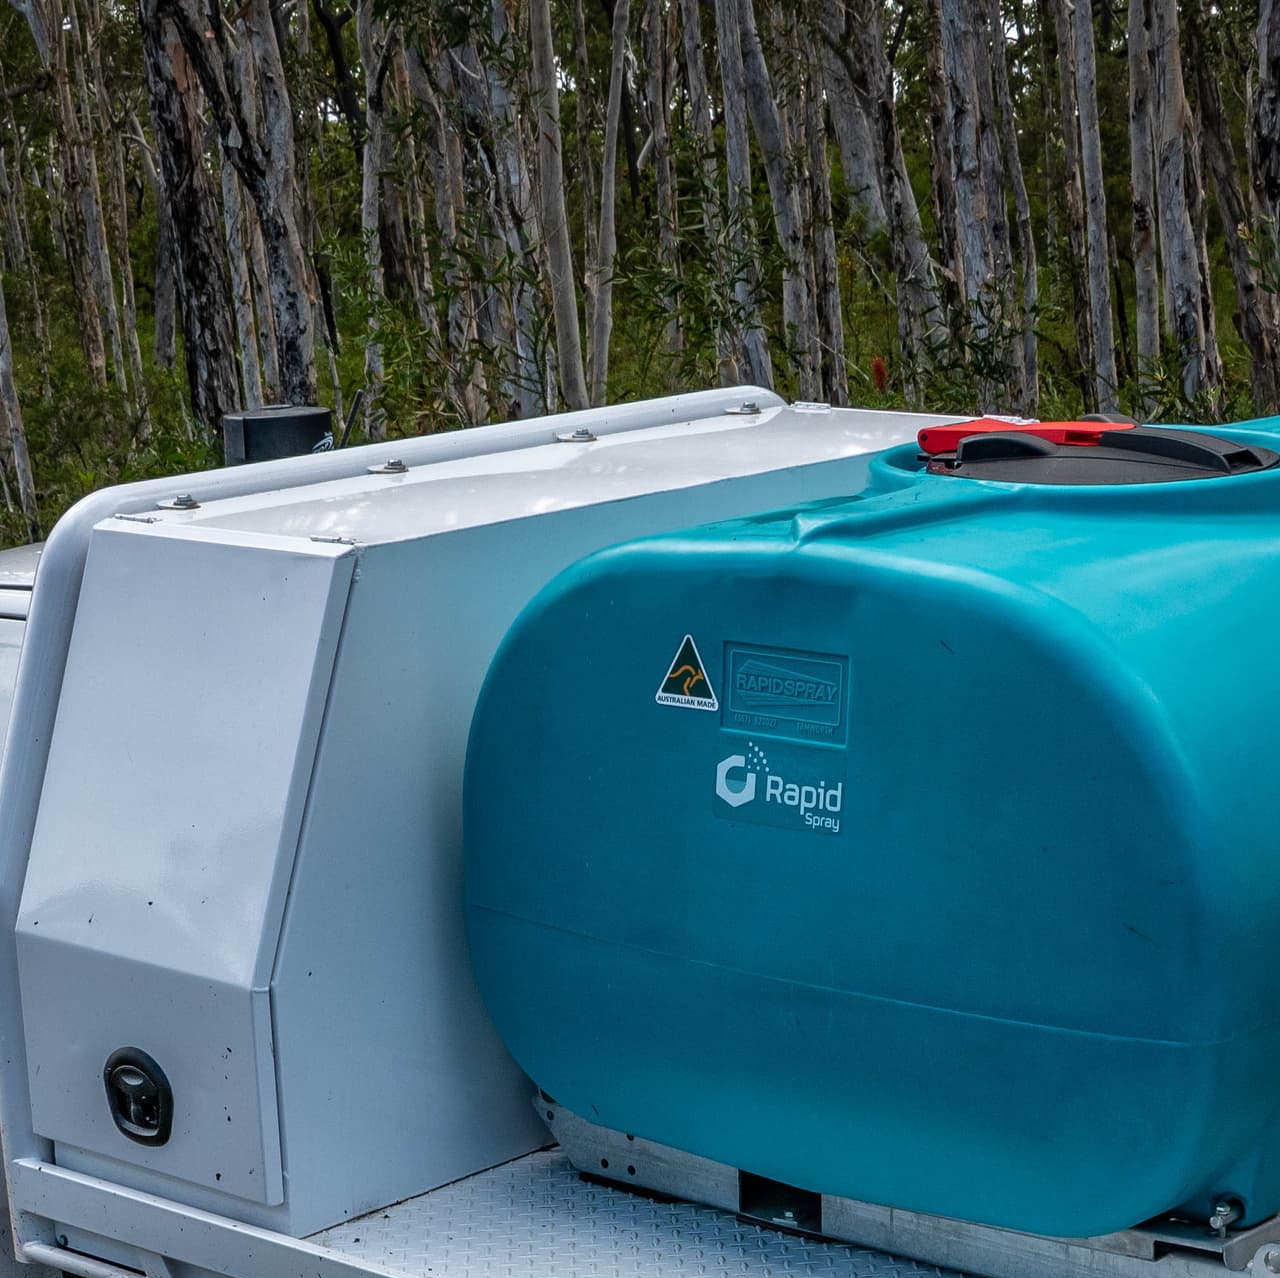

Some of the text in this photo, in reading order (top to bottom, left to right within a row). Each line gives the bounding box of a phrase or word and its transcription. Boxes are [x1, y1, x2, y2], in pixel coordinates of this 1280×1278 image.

[736, 674, 838, 702] RAPIDSPRAY
[657, 695, 717, 709] AUSTRALIAN MADE
[766, 775, 843, 815] Rapid
[805, 812, 840, 833] Spray
